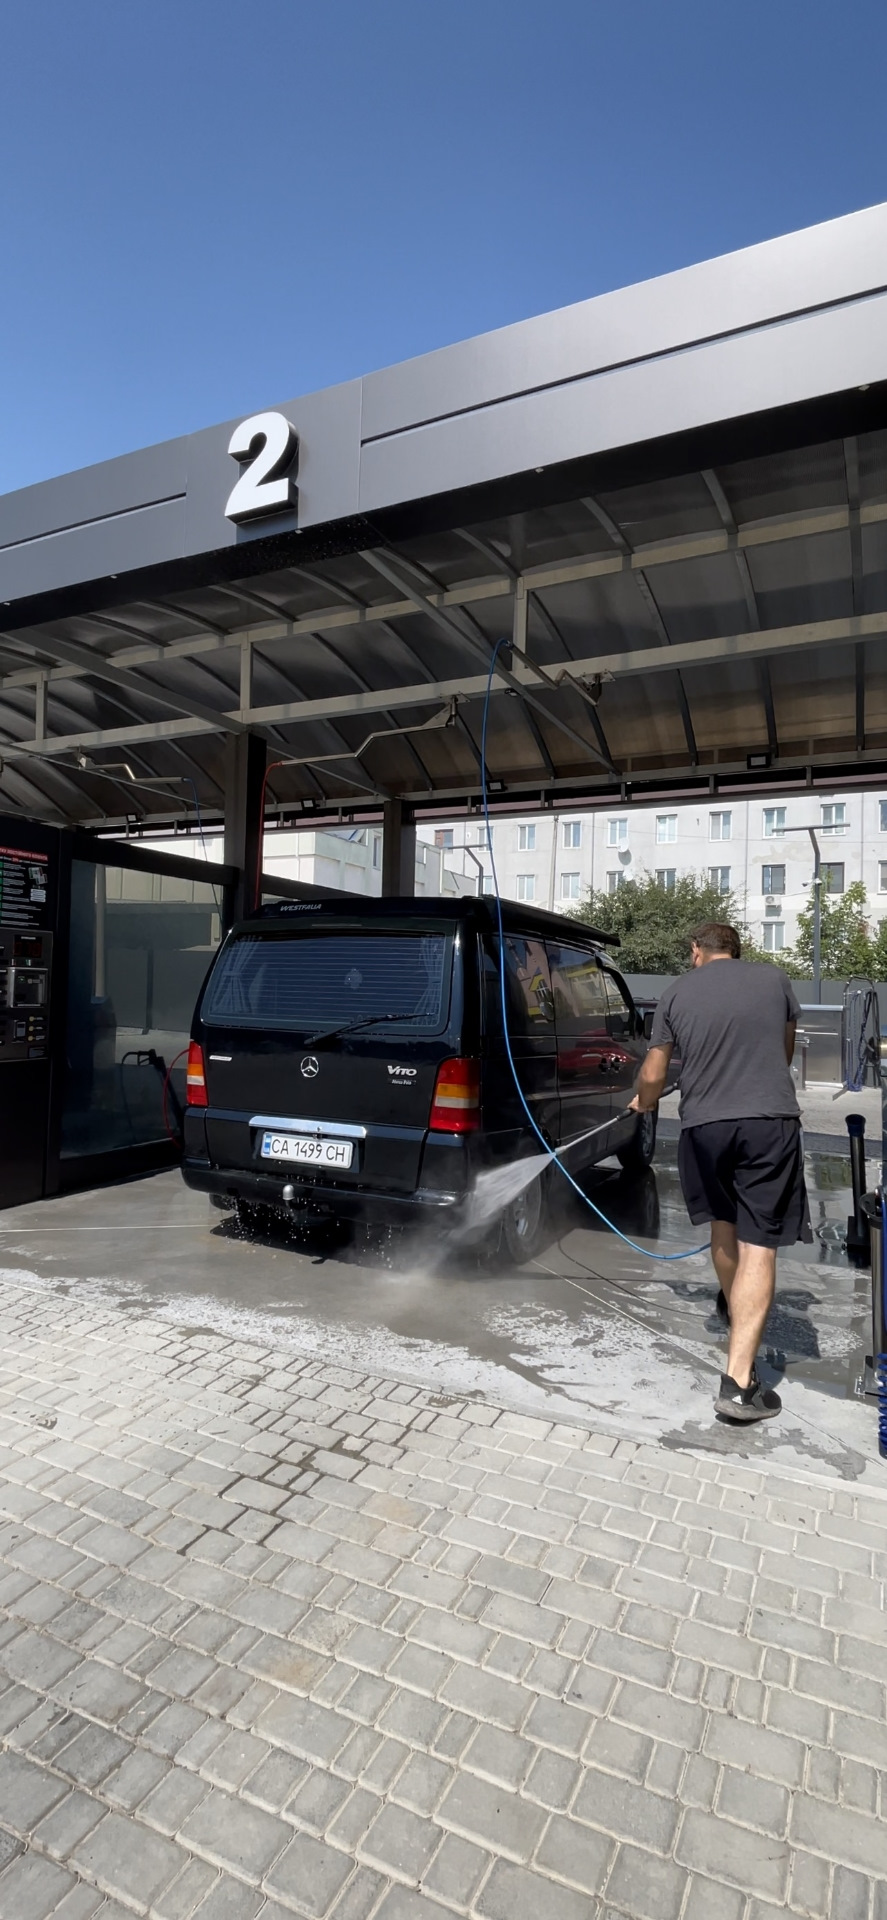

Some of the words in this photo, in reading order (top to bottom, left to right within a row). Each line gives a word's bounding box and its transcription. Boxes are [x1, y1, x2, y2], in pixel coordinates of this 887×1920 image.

[224, 411, 291, 517] 2
[280, 903, 322, 911] WESTFALIA
[271, 1138, 289, 1155] CA
[294, 1141, 323, 1159] 1499
[326, 1145, 346, 1162] CH
